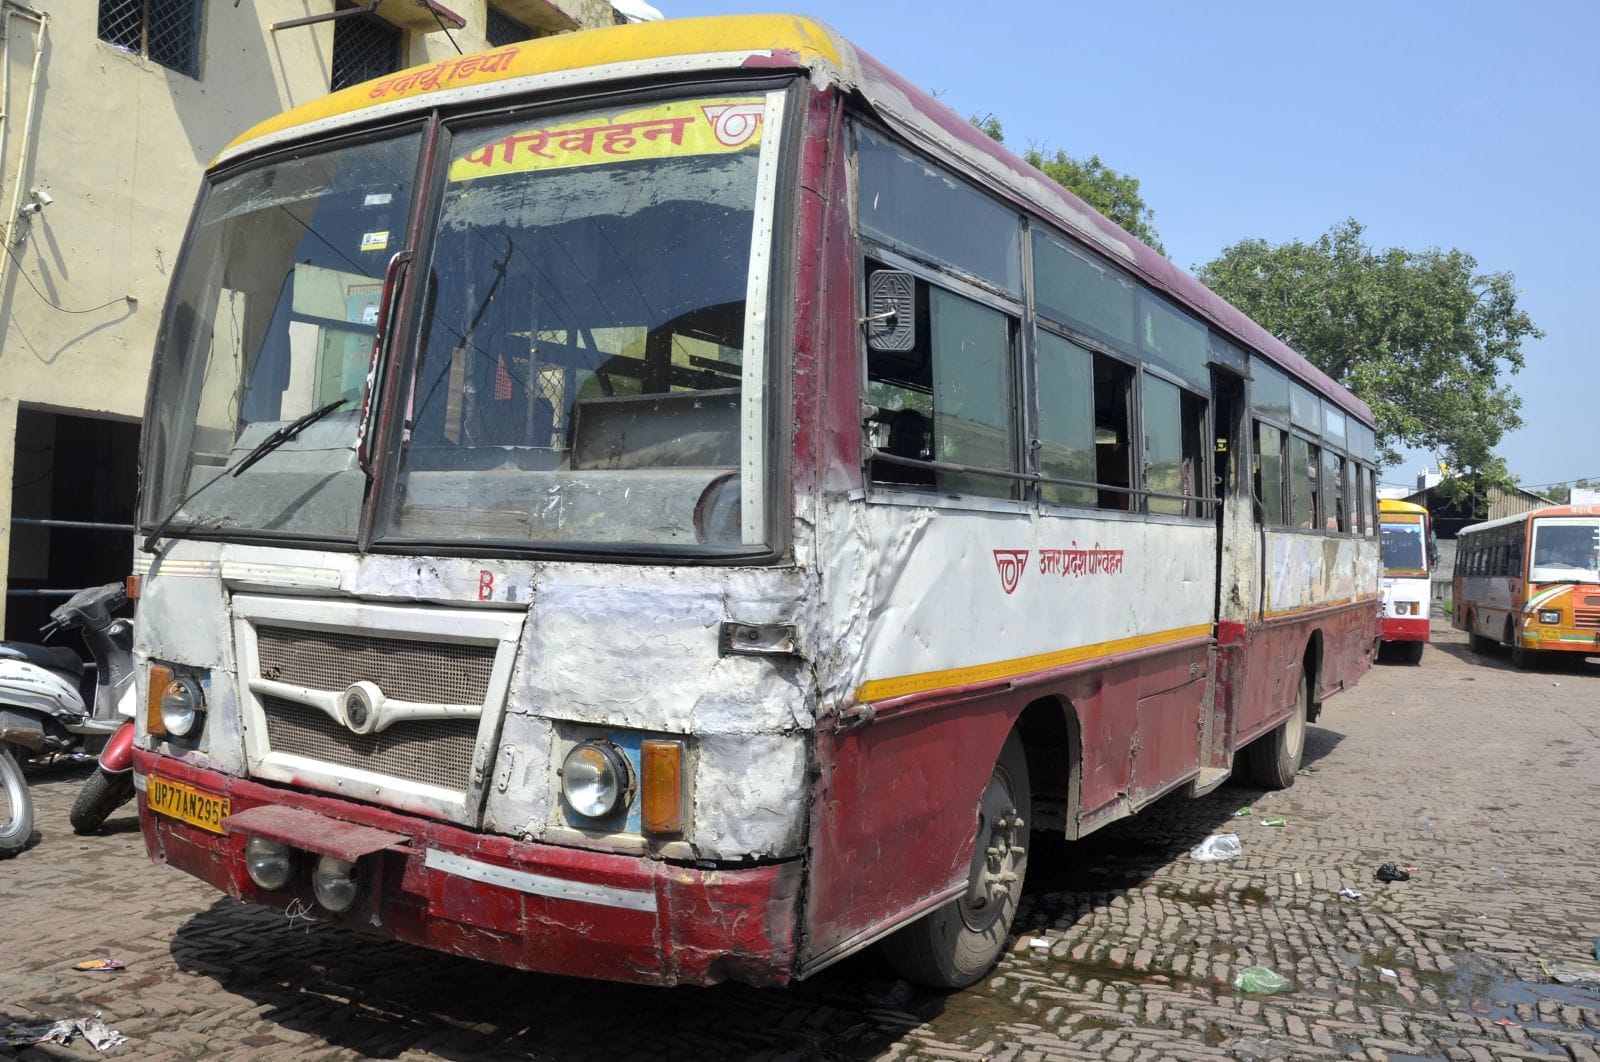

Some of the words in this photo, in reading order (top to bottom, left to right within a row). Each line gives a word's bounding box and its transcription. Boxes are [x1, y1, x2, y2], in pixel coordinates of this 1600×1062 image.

[1039, 549, 1061, 574] उत्तर
[1062, 540, 1087, 578] प्रदेश
[1088, 542, 1124, 576] परिवहन
